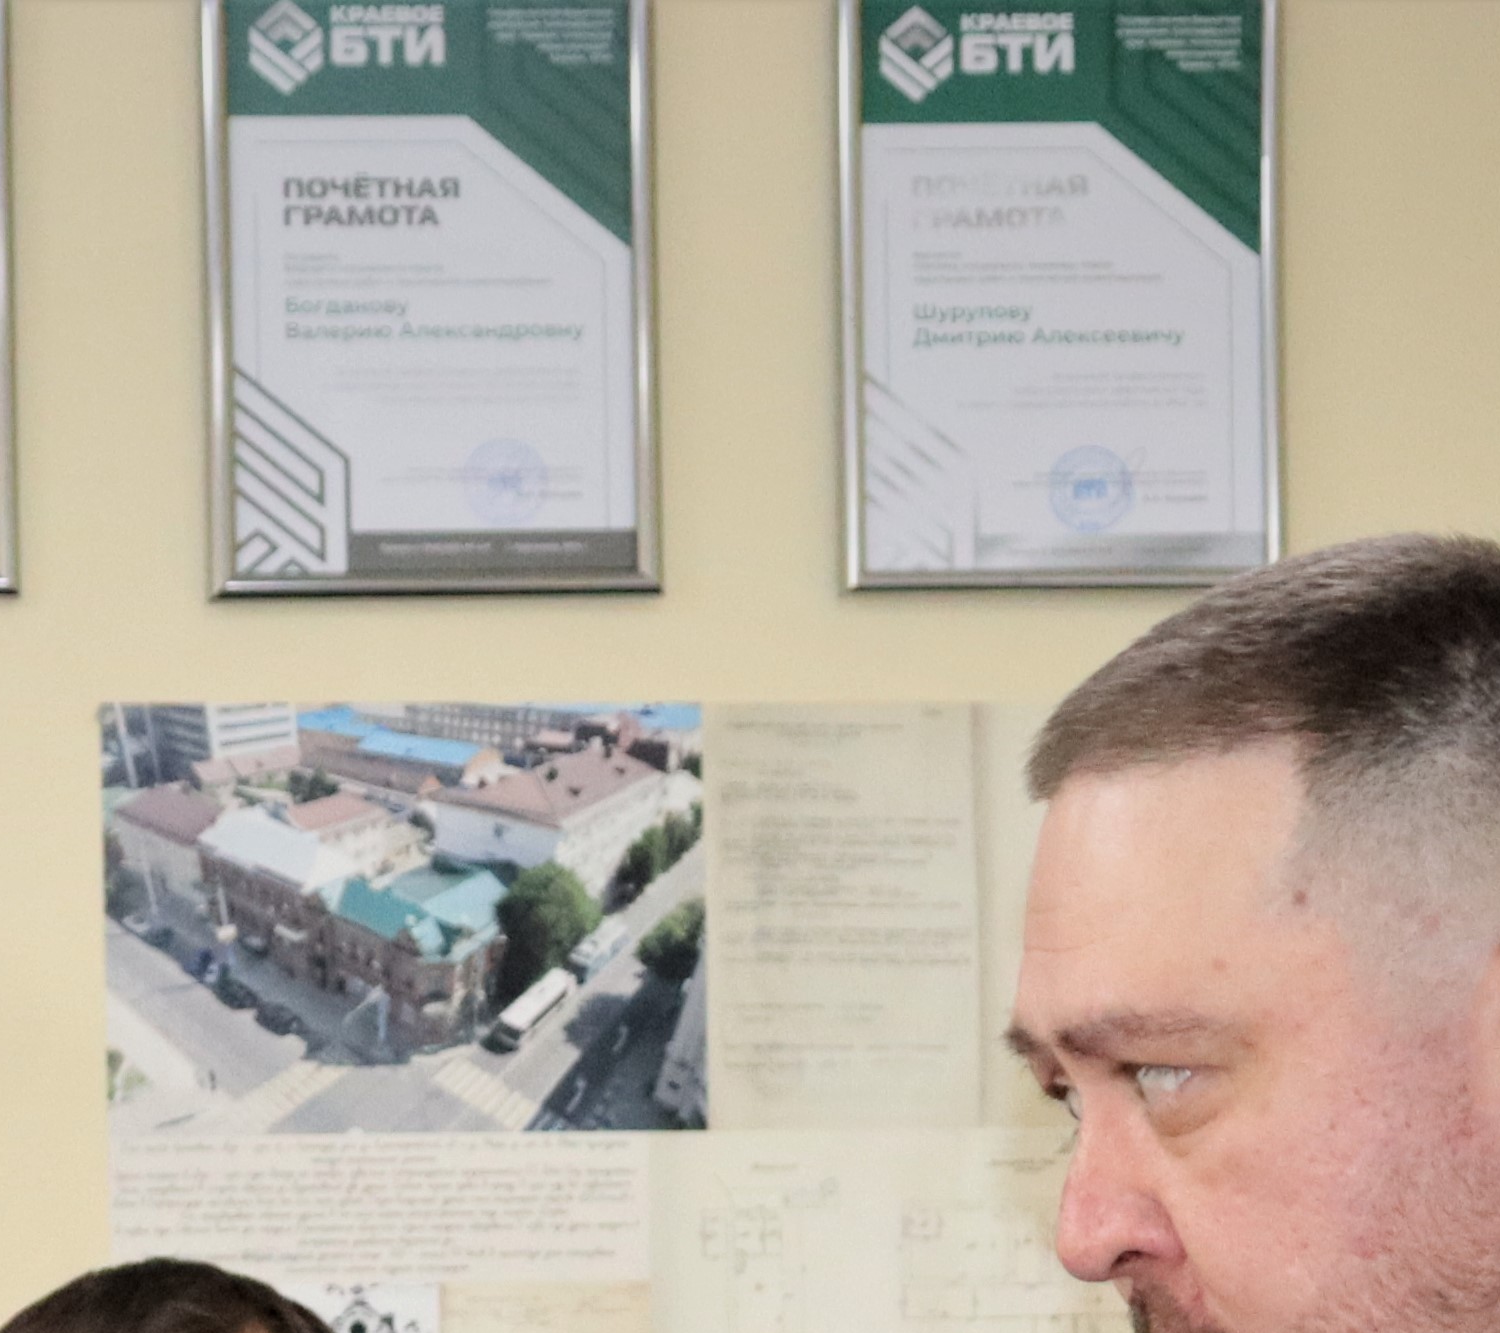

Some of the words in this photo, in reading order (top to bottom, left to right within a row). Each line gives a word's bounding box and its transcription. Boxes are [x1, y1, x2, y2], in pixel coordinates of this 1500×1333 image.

[330, 4, 444, 22] КРАЕВОЕ
[960, 13, 1074, 31] КРАЕВОЕ
[330, 25, 446, 67] БТИ
[960, 34, 1075, 73] БТИ
[283, 172, 461, 199] ПОЧЁТНАЯ
[284, 204, 440, 228] ГРАМОТА
[285, 297, 408, 317] Богданову
[285, 322, 392, 342] Валерию
[401, 322, 584, 343] Александровну
[913, 327, 1027, 348] Дмитрию
[1033, 328, 1185, 347] Алексеевичу
